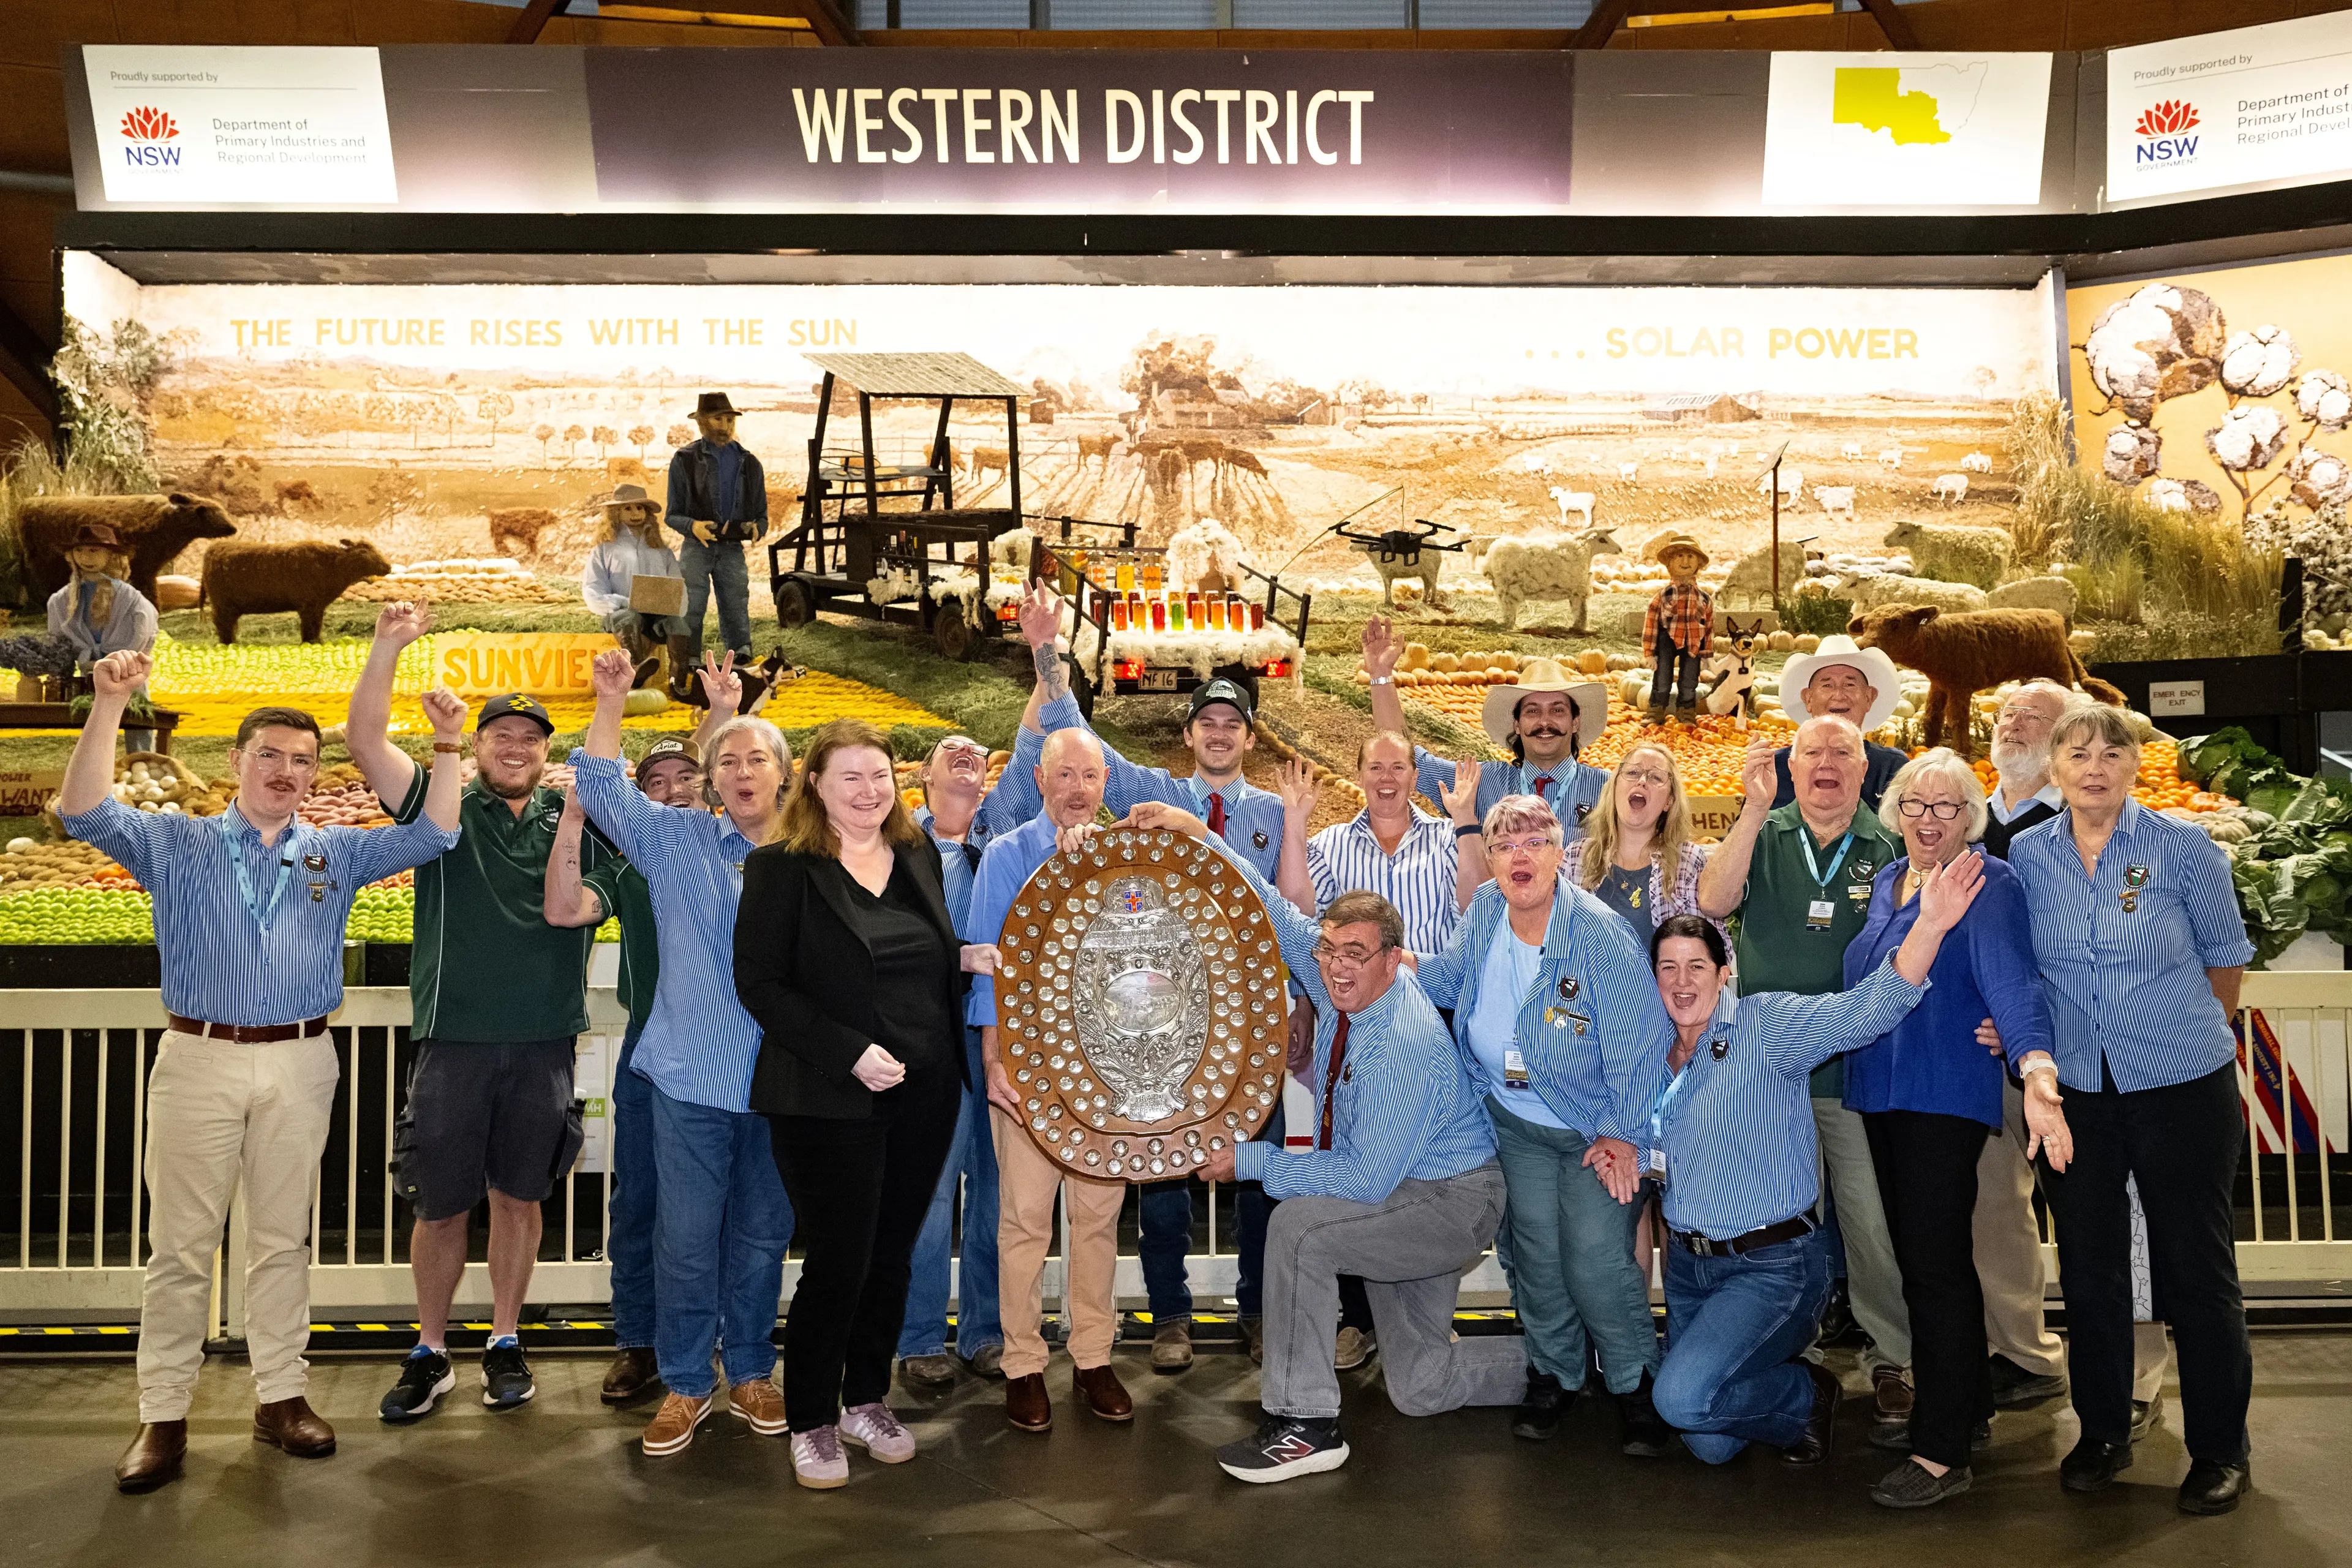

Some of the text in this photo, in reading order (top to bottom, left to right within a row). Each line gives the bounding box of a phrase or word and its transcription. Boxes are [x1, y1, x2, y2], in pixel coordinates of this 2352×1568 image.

[111, 71, 218, 83] Proudly supported by
[2134, 54, 2253, 81] Proudly supported by
[2238, 83, 2349, 112] Department of
[213, 119, 307, 132] Department of
[792, 88, 1374, 165] WESTERN DISTRICT
[2238, 111, 2296, 129] Primary
[216, 135, 366, 148] Primary Industries and
[2237, 125, 2302, 145] Regional
[125, 146, 181, 166] NSW
[218, 152, 367, 165] Regional Development
[2136, 135, 2199, 164] NSW
[2136, 157, 2198, 172] GOVERNMENT
[230, 318, 857, 347] THE FUTURE RISES WITH THE SUN
[1605, 326, 1745, 360] SOLAR
[1769, 328, 1919, 360] POWER
[442, 648, 598, 688] SUNVIE
[654, 742, 678, 752] Ariat
[0, 773, 31, 783] OWER
[2, 788, 55, 805] WANT
